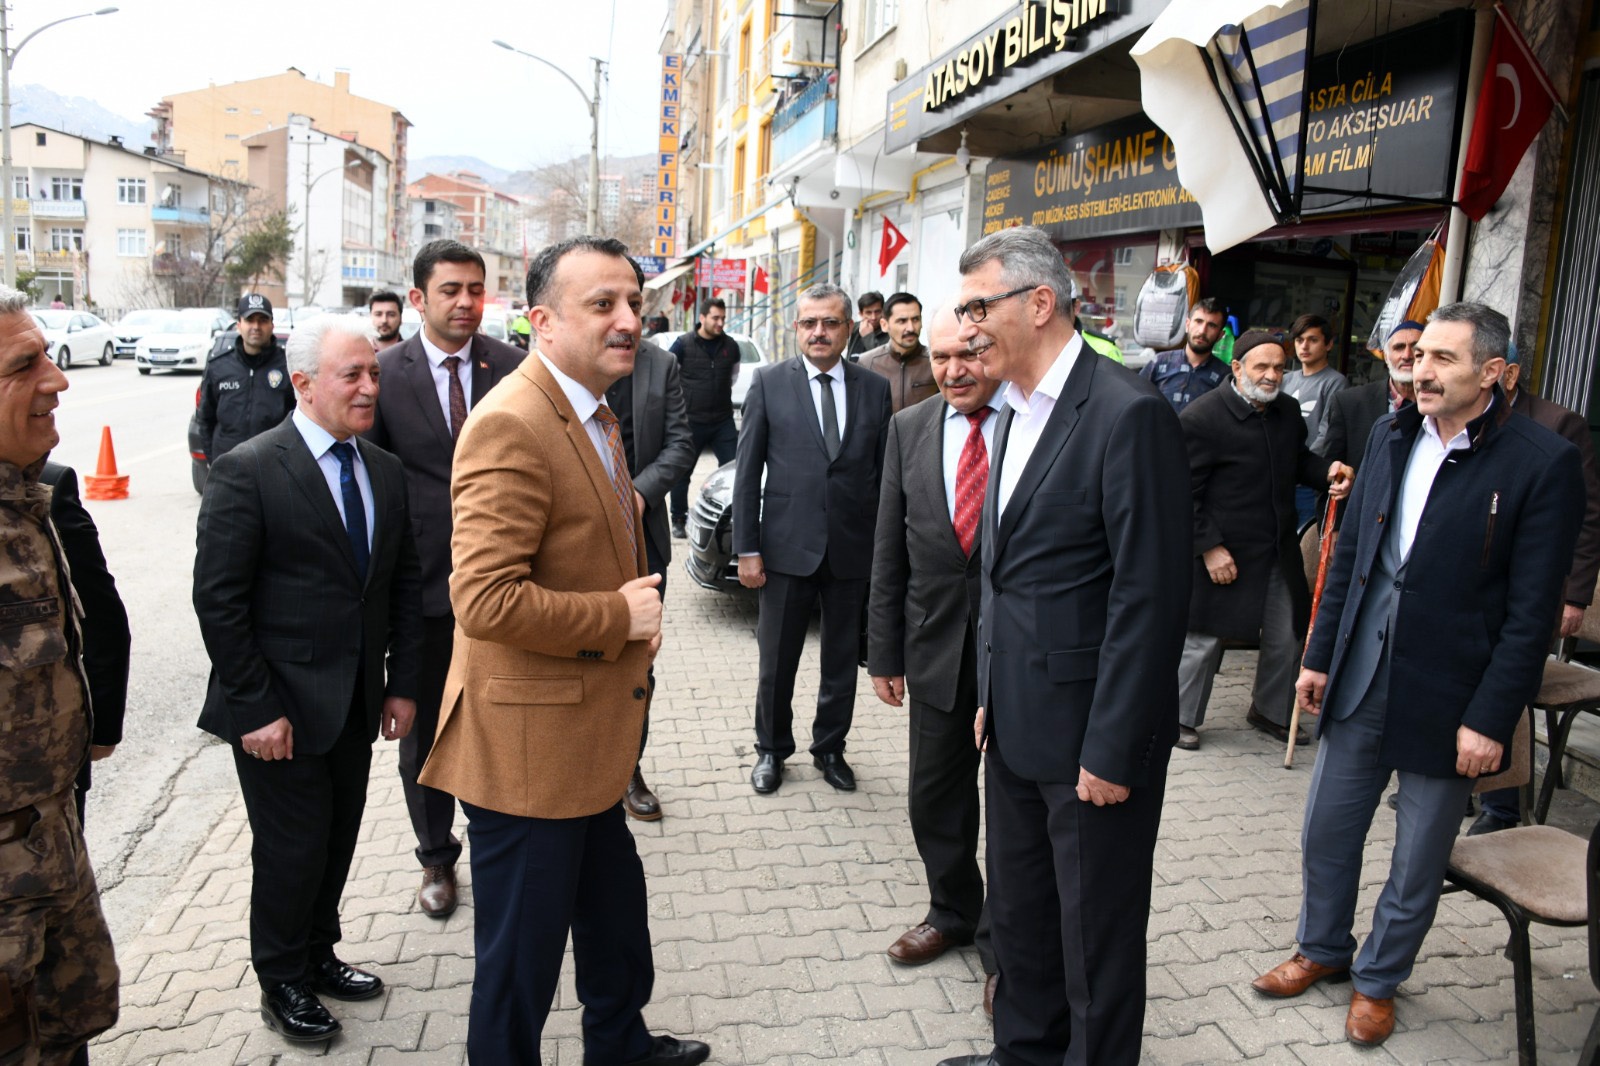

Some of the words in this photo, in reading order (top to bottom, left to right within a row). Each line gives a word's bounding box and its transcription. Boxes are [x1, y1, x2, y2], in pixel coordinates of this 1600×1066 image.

[662, 56, 679, 135] EKMEK
[922, 28, 1000, 112] ATASOY
[1351, 72, 1392, 103] CİLA
[1327, 95, 1433, 140] AKSESUAR
[1034, 129, 1156, 197] GÜMÜŞHANE
[658, 154, 674, 253] FIRINI
